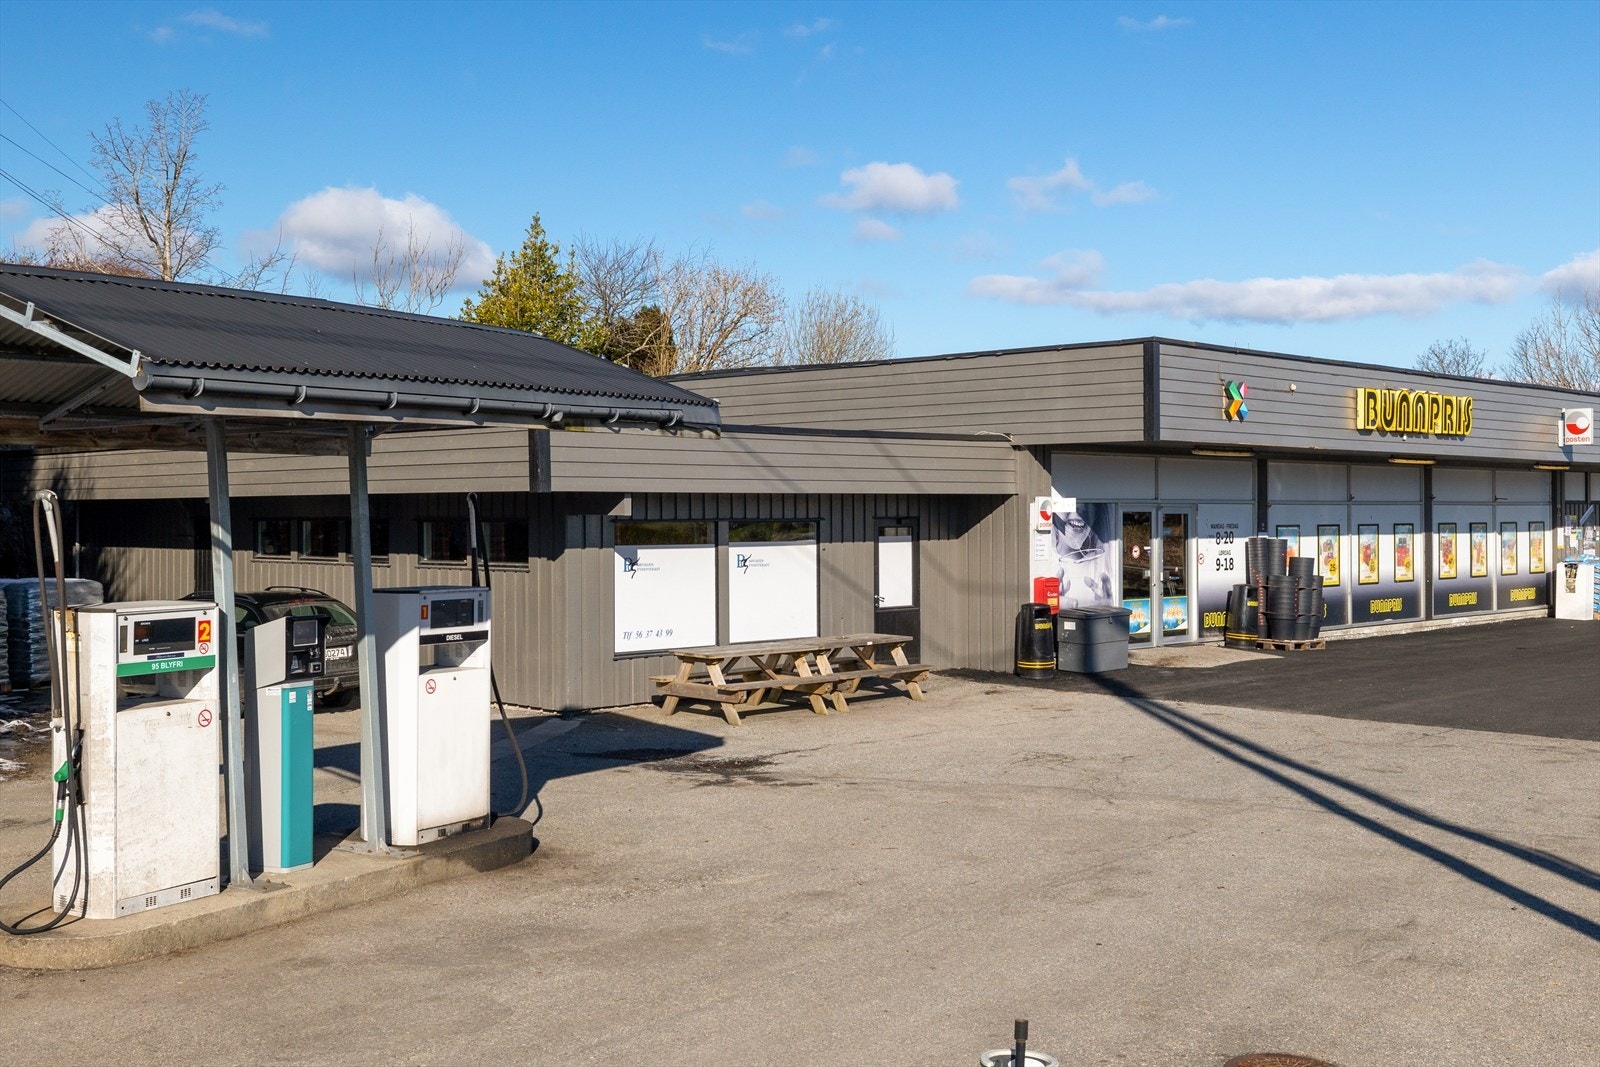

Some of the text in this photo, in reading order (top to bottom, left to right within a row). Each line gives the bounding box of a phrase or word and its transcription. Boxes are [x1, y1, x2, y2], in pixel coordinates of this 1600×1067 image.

[1357, 387, 1473, 436] BUNNPRIS
[1215, 531, 1234, 545] 8-20
[1215, 557, 1234, 571] 9-18
[1370, 598, 1402, 613] BUNNPRIS
[199, 622, 210, 640] 2
[665, 628, 673, 637] 99
[161, 661, 183, 669] BLYFRI
